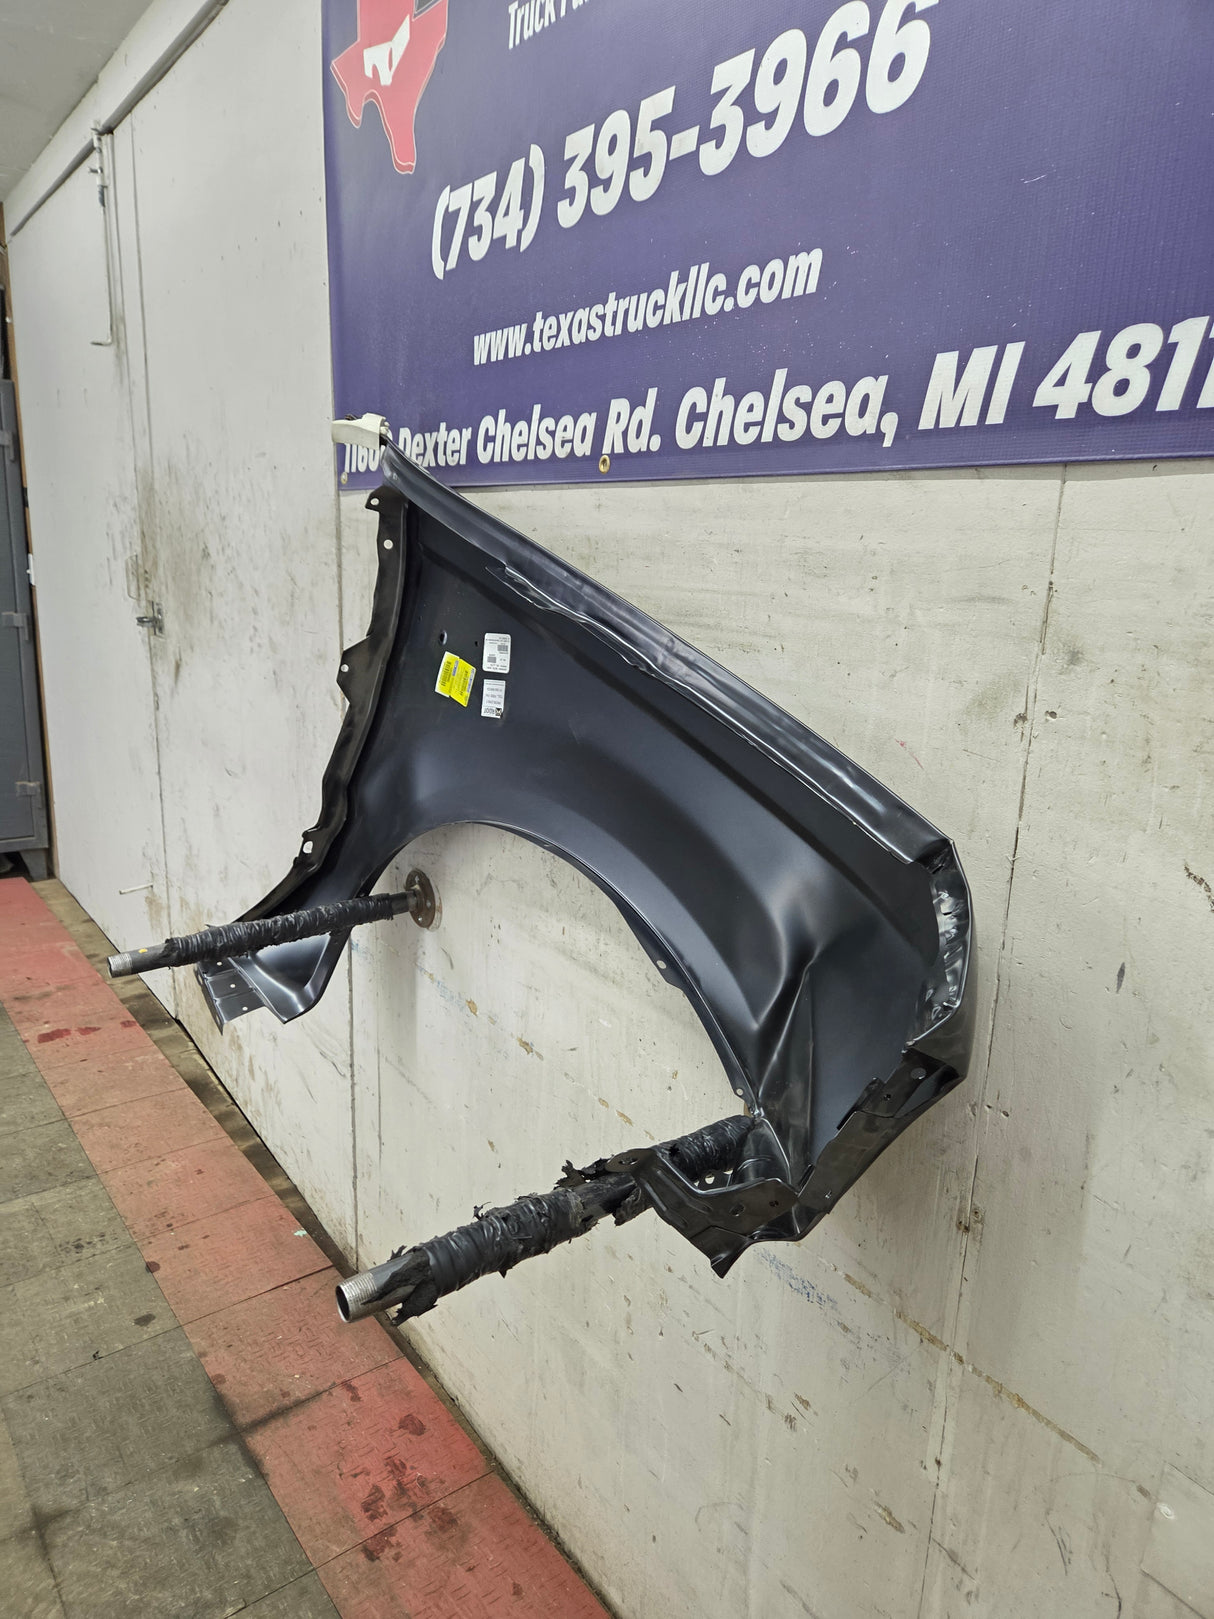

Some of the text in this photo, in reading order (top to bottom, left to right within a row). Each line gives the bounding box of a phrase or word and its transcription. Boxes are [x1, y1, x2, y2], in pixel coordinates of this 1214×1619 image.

[431, 0, 940, 281] (734) 395-3966
[473, 247, 823, 366] www.texastruckllc.com
[344, 430, 393, 473] 1160
[477, 403, 597, 464] Chelsea
[602, 387, 661, 454] Rd.
[675, 368, 899, 449] Chelsea,
[917, 341, 1026, 431] MI
[1032, 315, 1214, 420] 481
